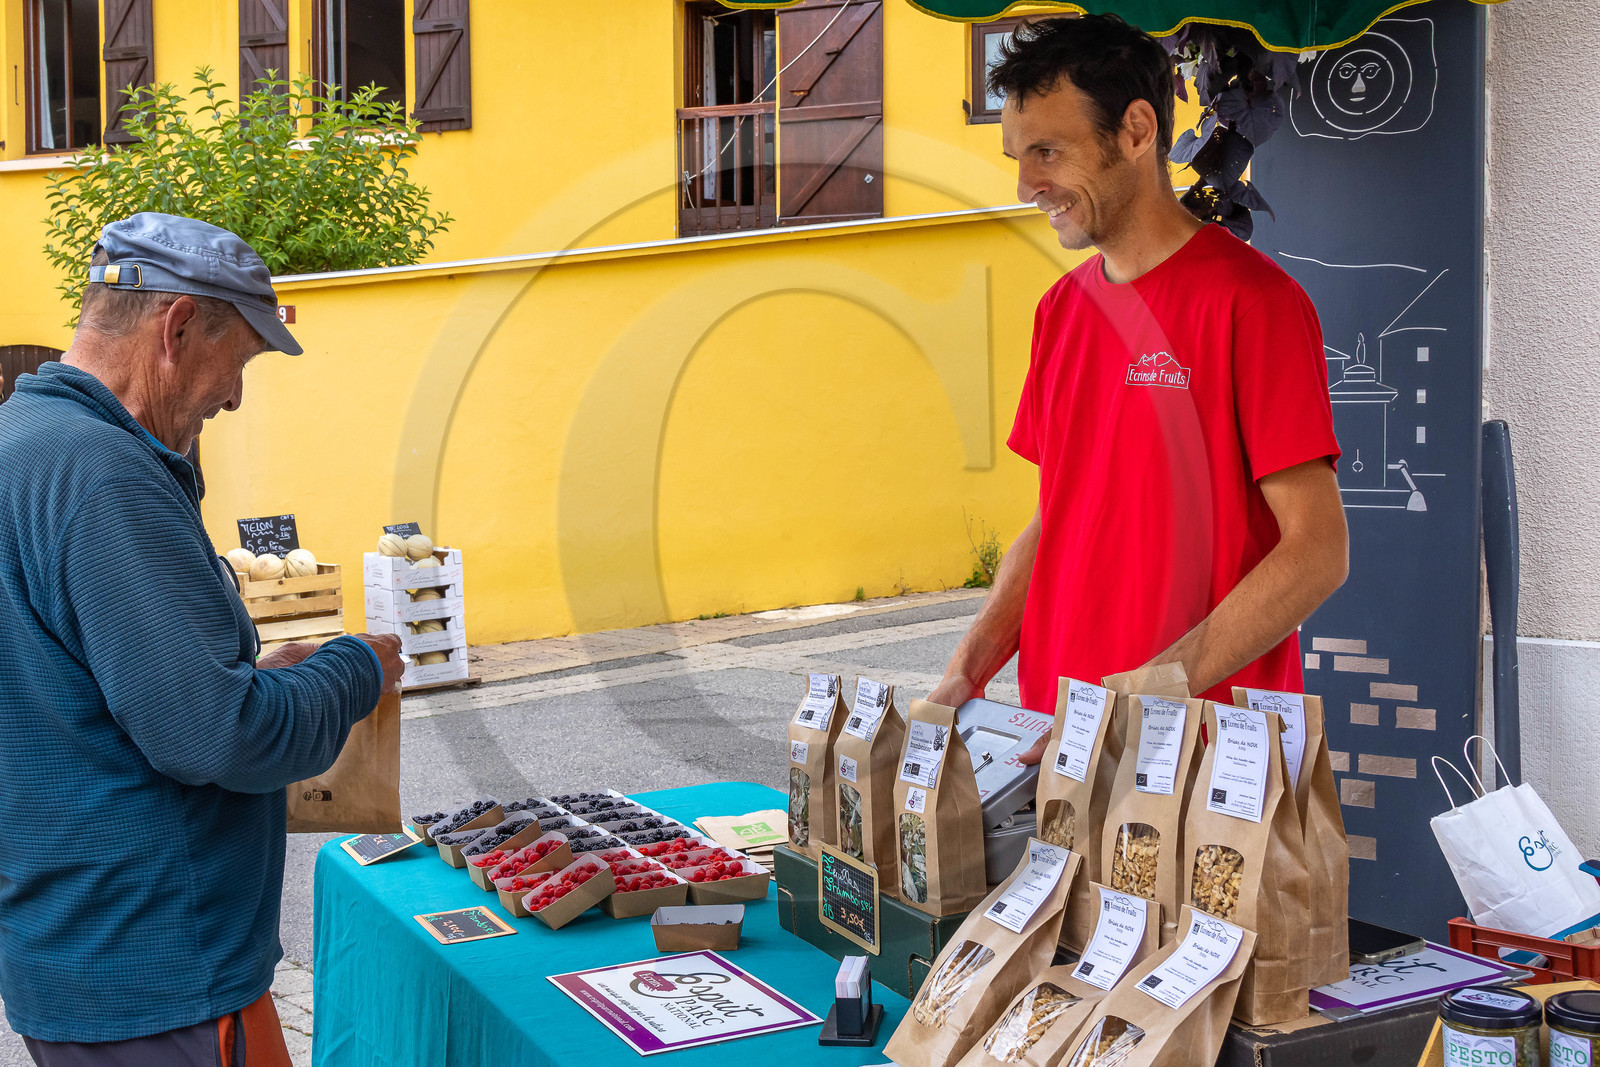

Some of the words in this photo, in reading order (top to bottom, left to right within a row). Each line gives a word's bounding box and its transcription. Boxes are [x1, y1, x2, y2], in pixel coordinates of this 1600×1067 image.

[278, 306, 286, 322] 9
[1159, 369, 1186, 384] Fruits
[630, 972, 764, 1018] Esprit
[660, 1002, 702, 1030] NATIONAL
[675, 998, 724, 1026] PARC
[1449, 1042, 1512, 1065] PESTO
[1550, 1039, 1588, 1064] STO
